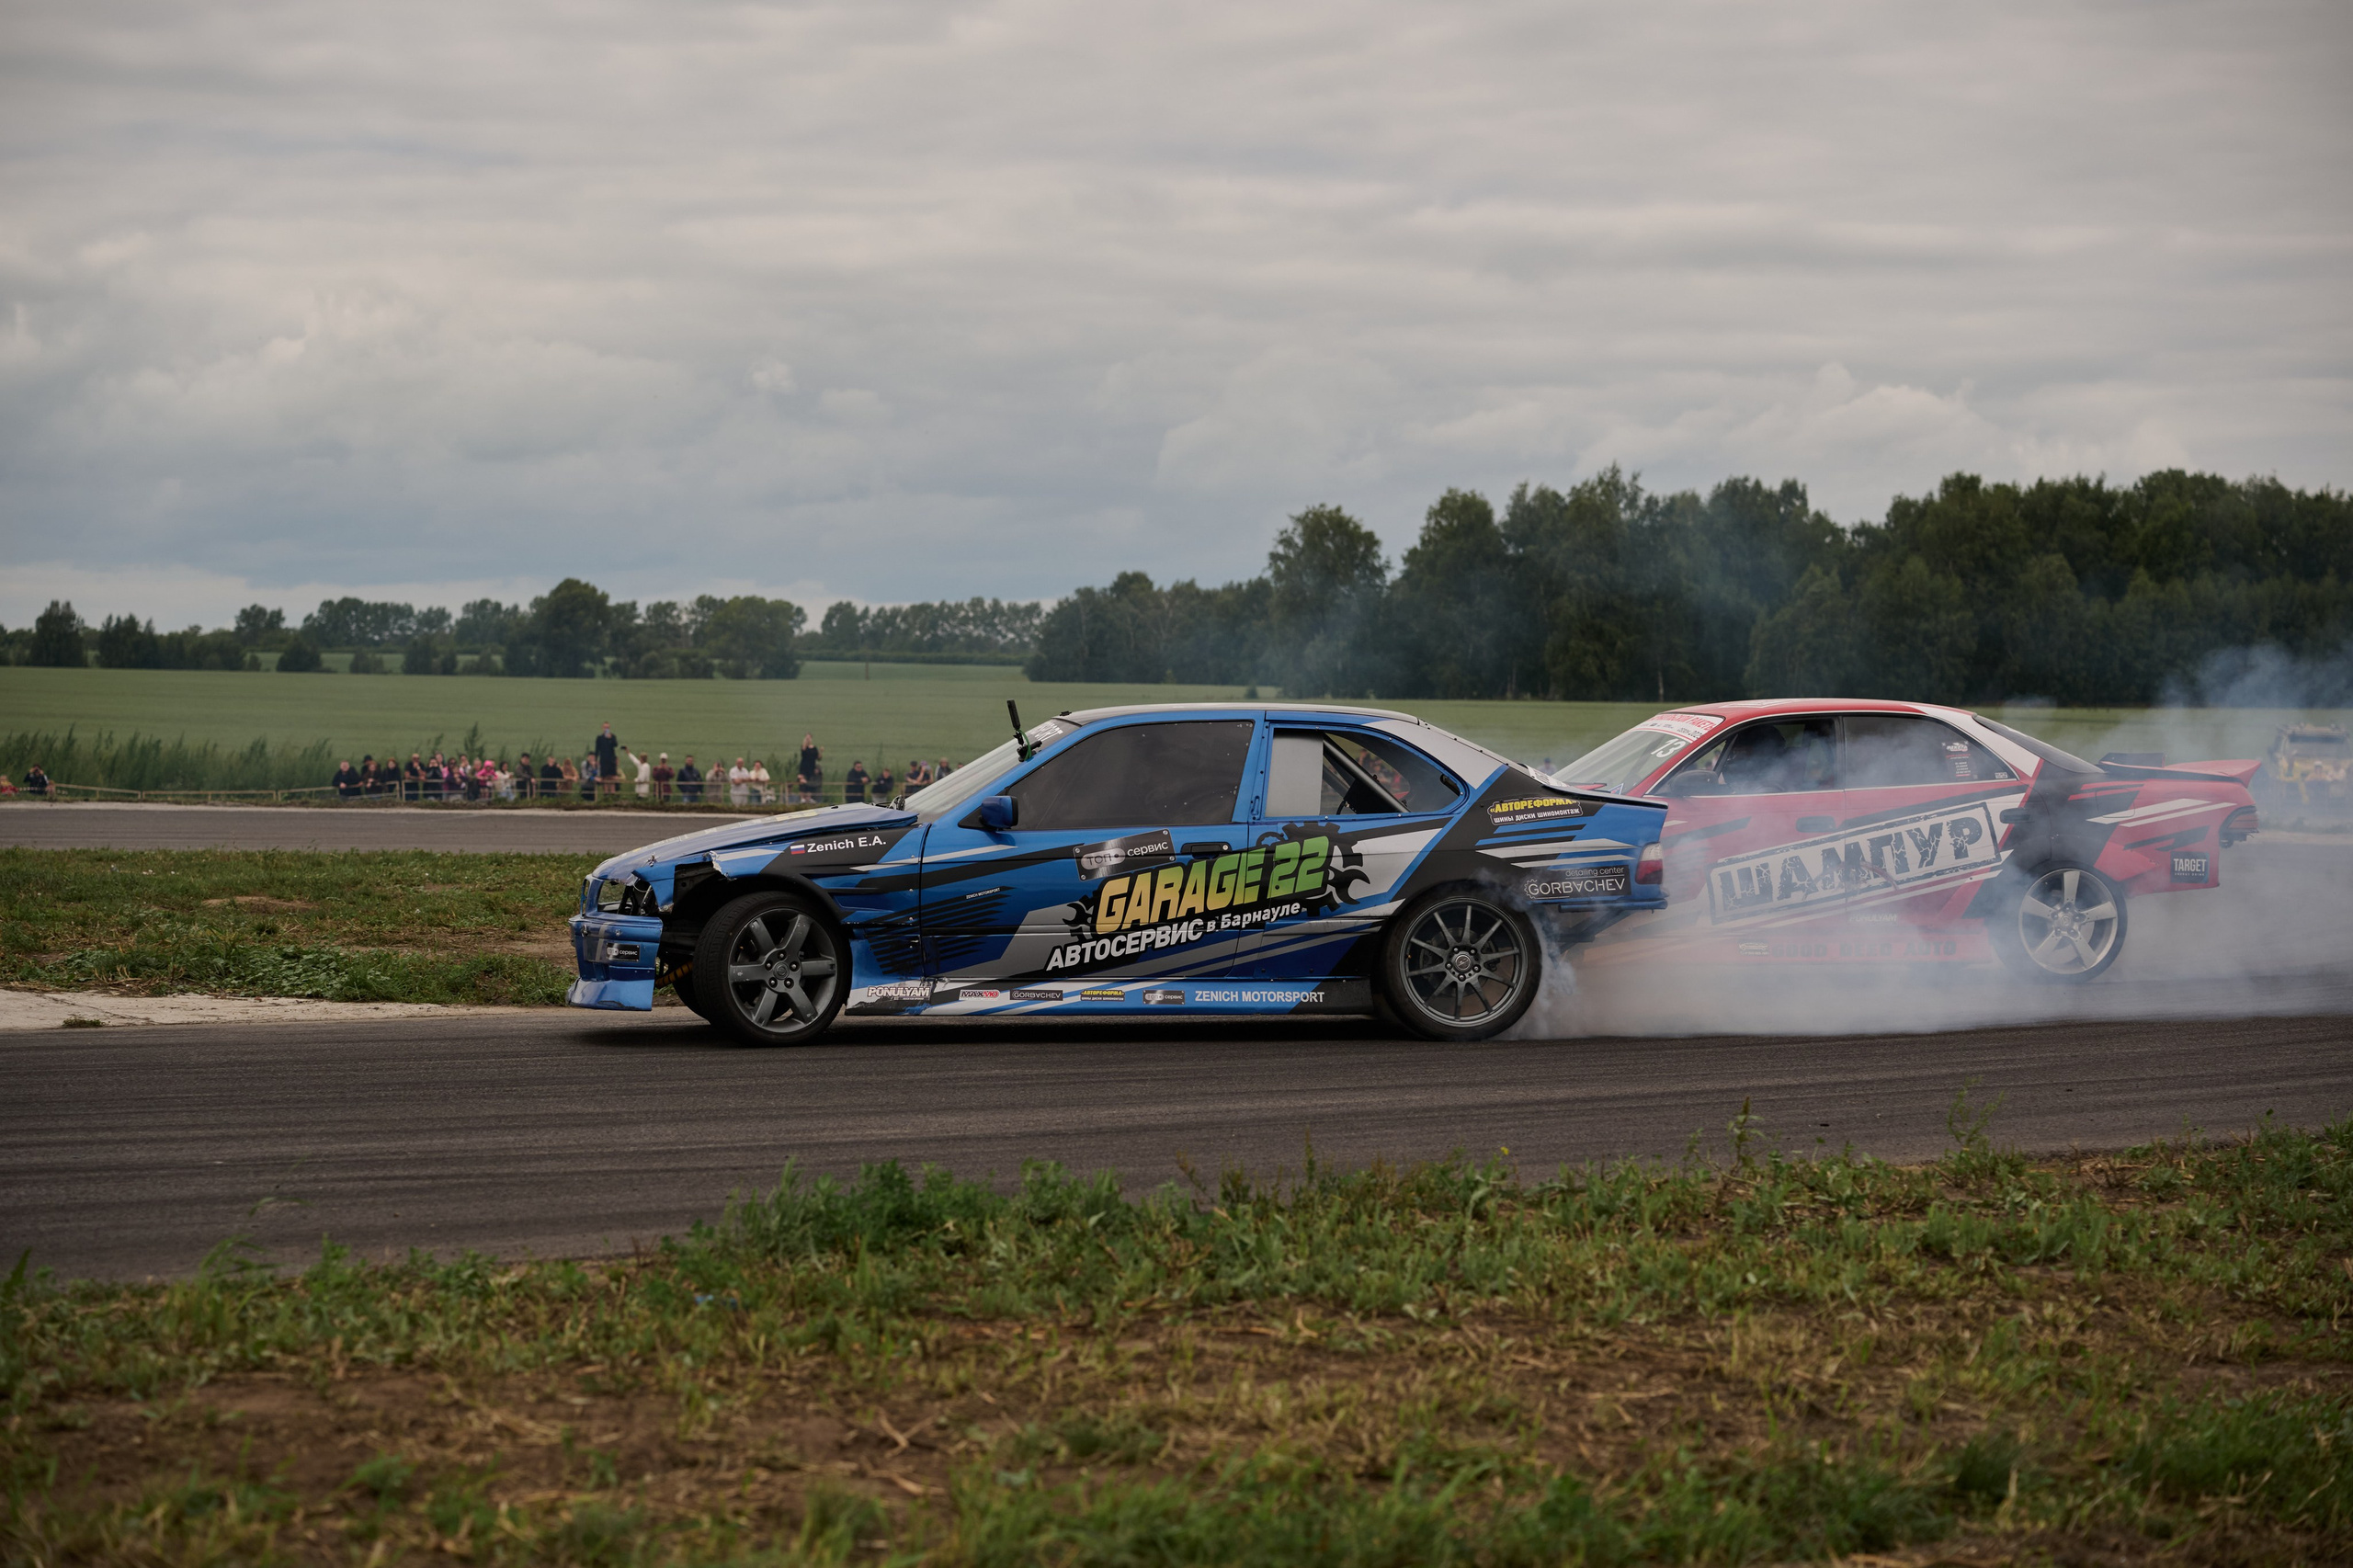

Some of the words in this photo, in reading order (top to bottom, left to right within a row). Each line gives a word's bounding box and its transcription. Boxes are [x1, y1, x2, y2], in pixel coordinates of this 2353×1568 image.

[1651, 738, 1687, 758] 13
[1490, 798, 1577, 813] «АВТОРЕФОРМА»
[807, 838, 854, 853] Zenich
[858, 835, 886, 847] E.A.
[1127, 841, 1168, 857] сервис
[1565, 868, 1598, 877] detailing
[1719, 816, 1983, 913] ШАМПУР
[2173, 858, 2207, 872] TARGET
[1096, 847, 1267, 935] GARAGE
[1267, 835, 1329, 899] 22
[1046, 918, 1203, 971] АВТОСЕРВИС
[1206, 920, 1216, 932] в
[1221, 901, 1301, 929] Барнауле
[1904, 940, 1957, 957] AUTO
[868, 986, 930, 997] PONULYAM
[1195, 991, 1238, 1002] ZENICH
[1242, 991, 1324, 1003] MOTORSPORT
